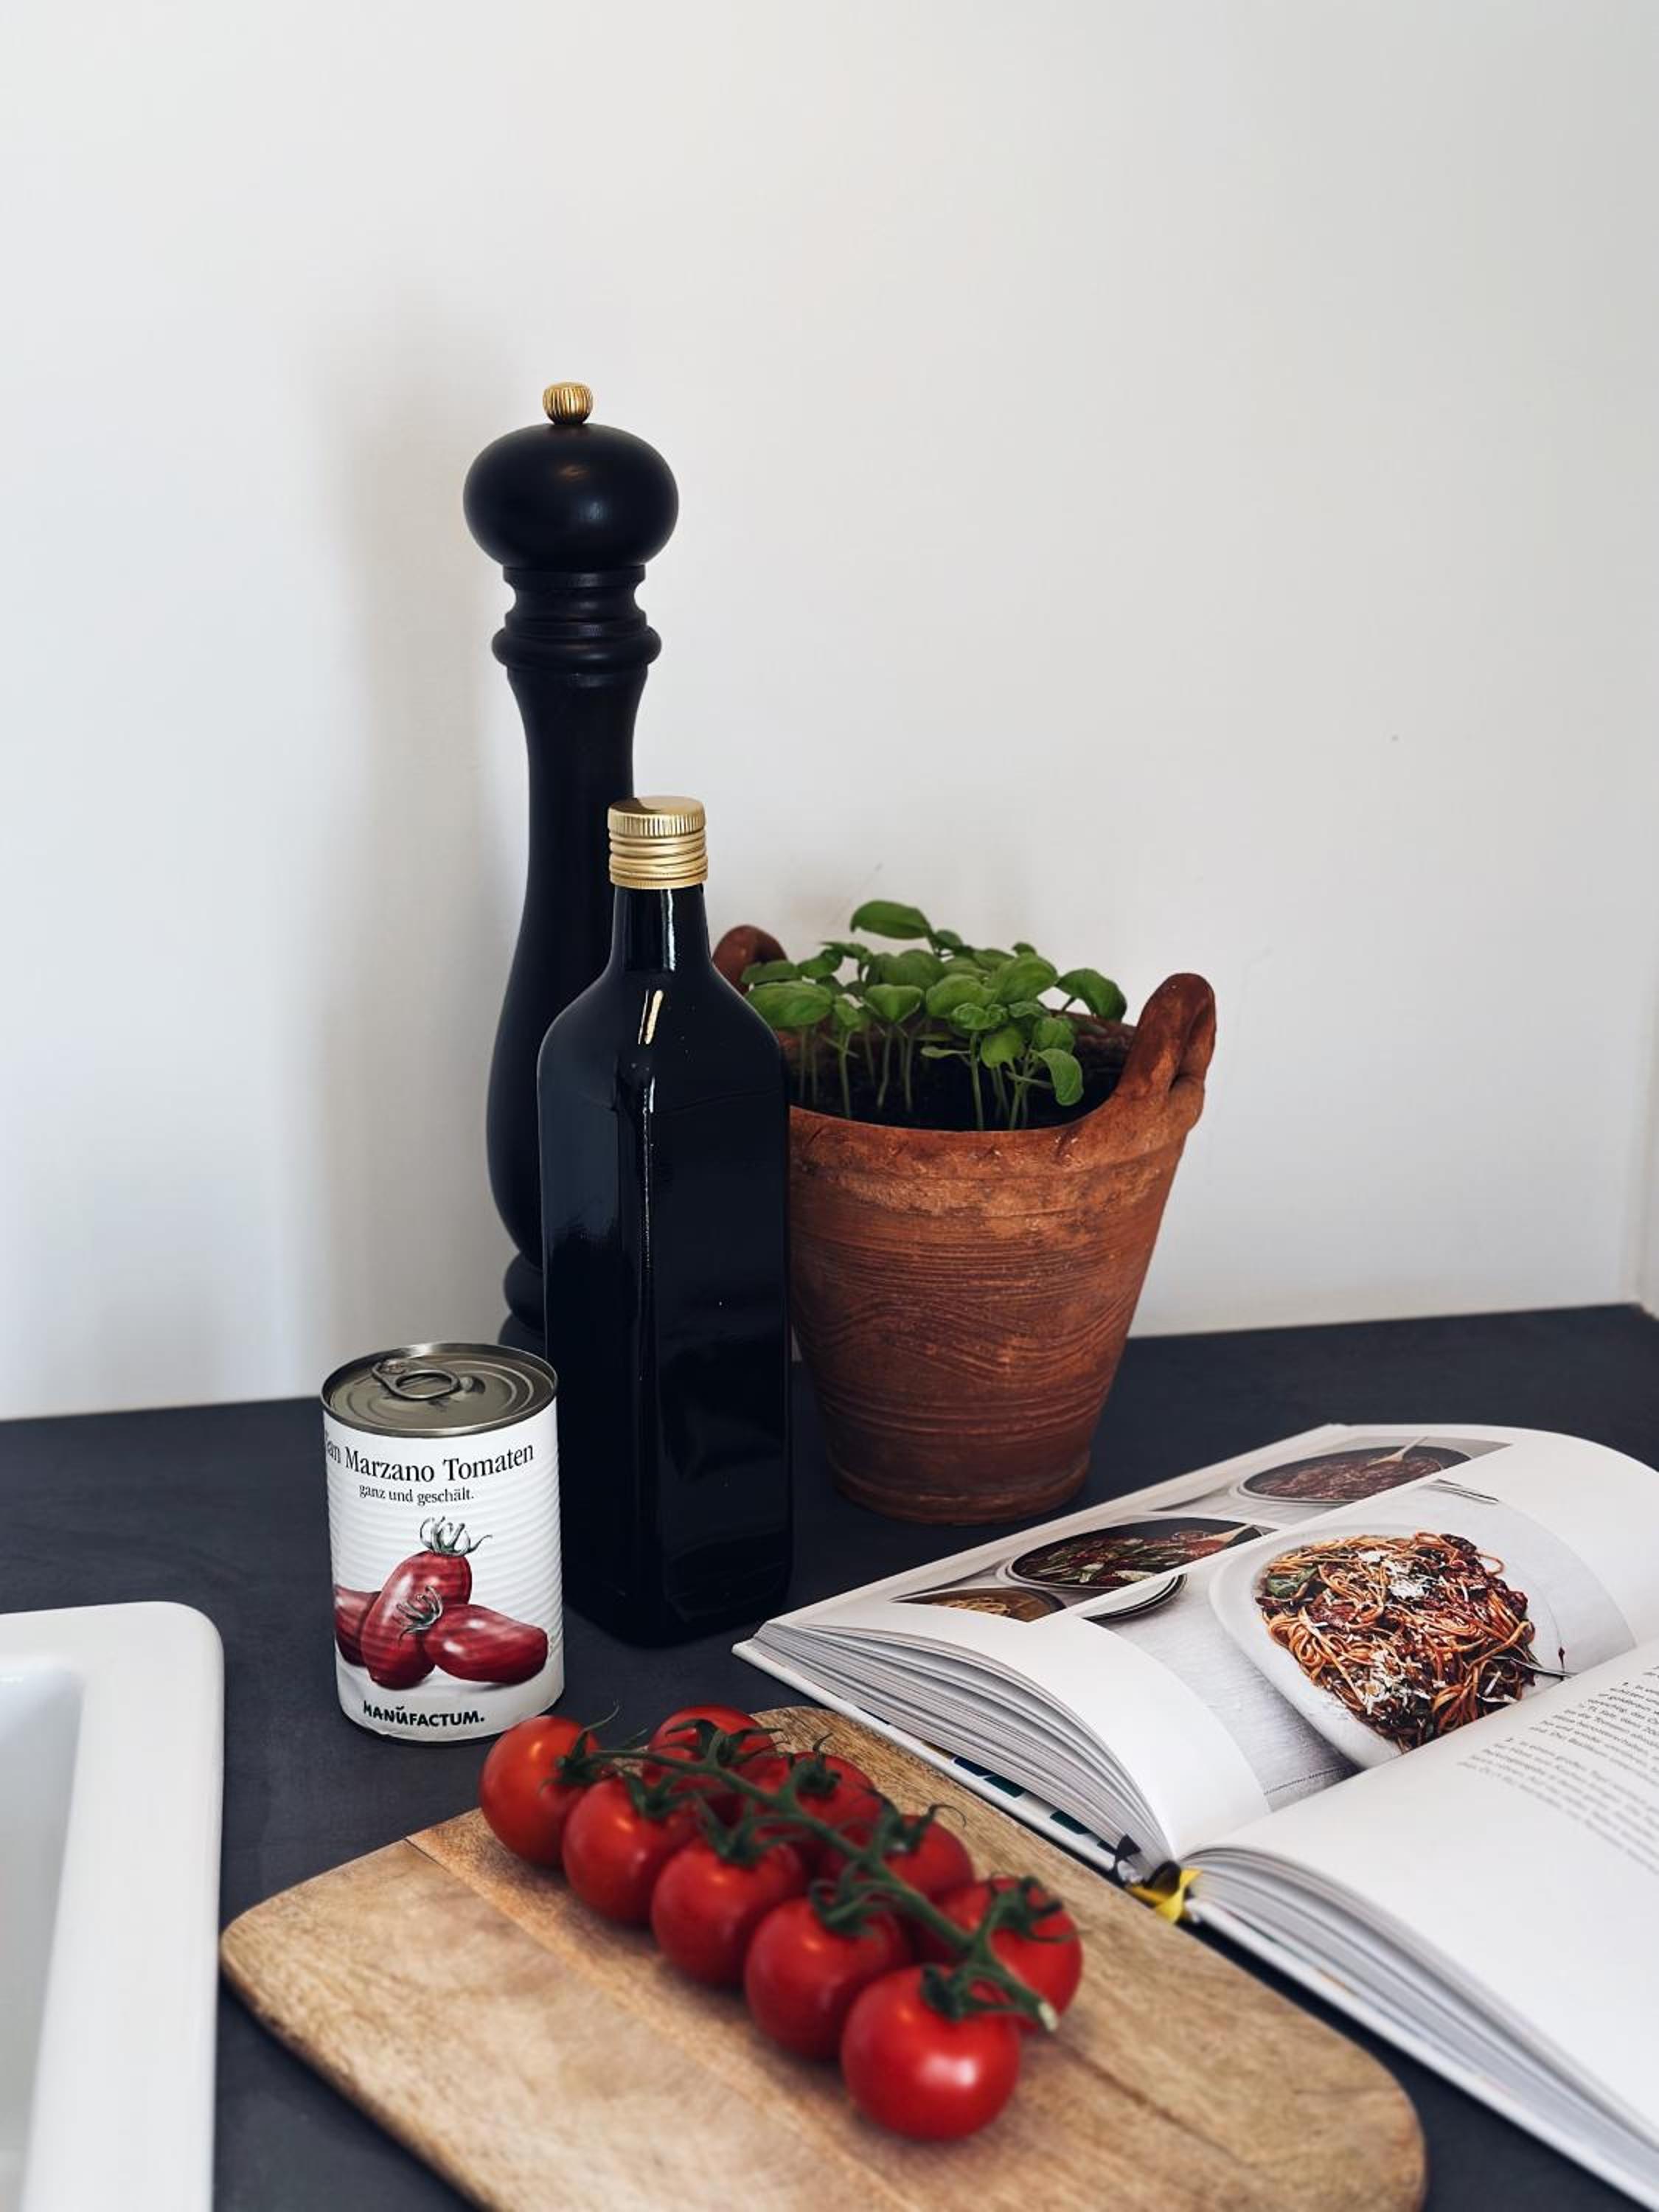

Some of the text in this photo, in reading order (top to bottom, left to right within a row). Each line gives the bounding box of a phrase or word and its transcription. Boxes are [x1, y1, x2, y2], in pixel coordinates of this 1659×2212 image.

[325, 1430, 534, 1482] an Marzano Tomaten
[358, 1484, 474, 1506] ganz und geschält.
